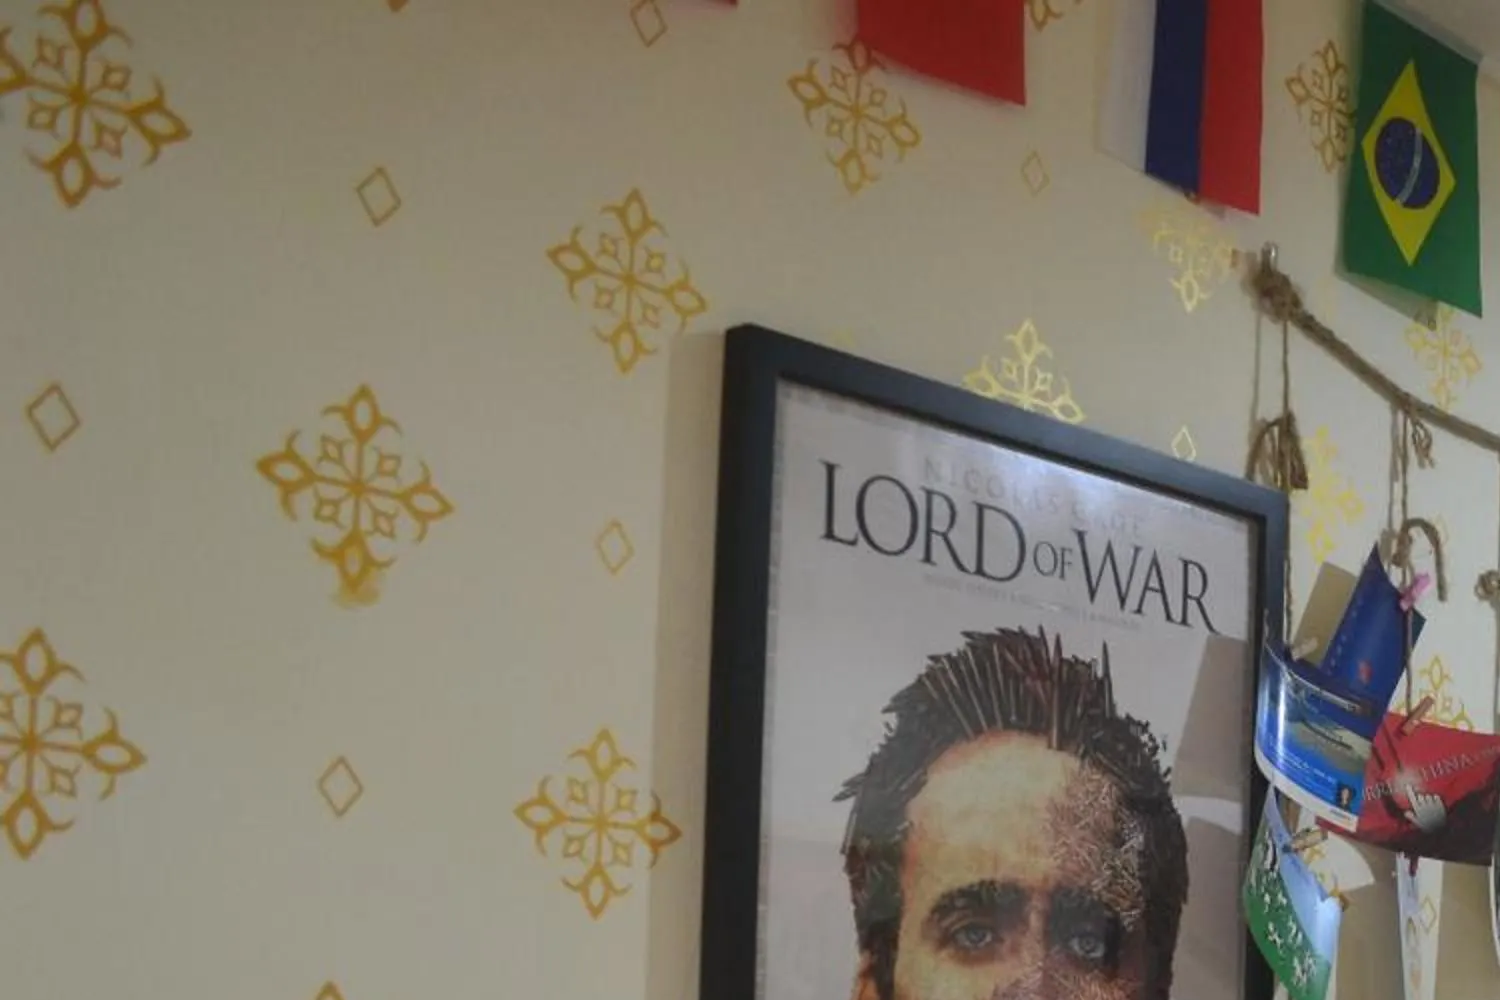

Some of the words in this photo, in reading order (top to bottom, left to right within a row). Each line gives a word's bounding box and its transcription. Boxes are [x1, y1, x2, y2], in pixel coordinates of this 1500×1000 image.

[820, 459, 1027, 583] LORD
[1033, 541, 1074, 581] OF
[1071, 528, 1221, 635] WAR
